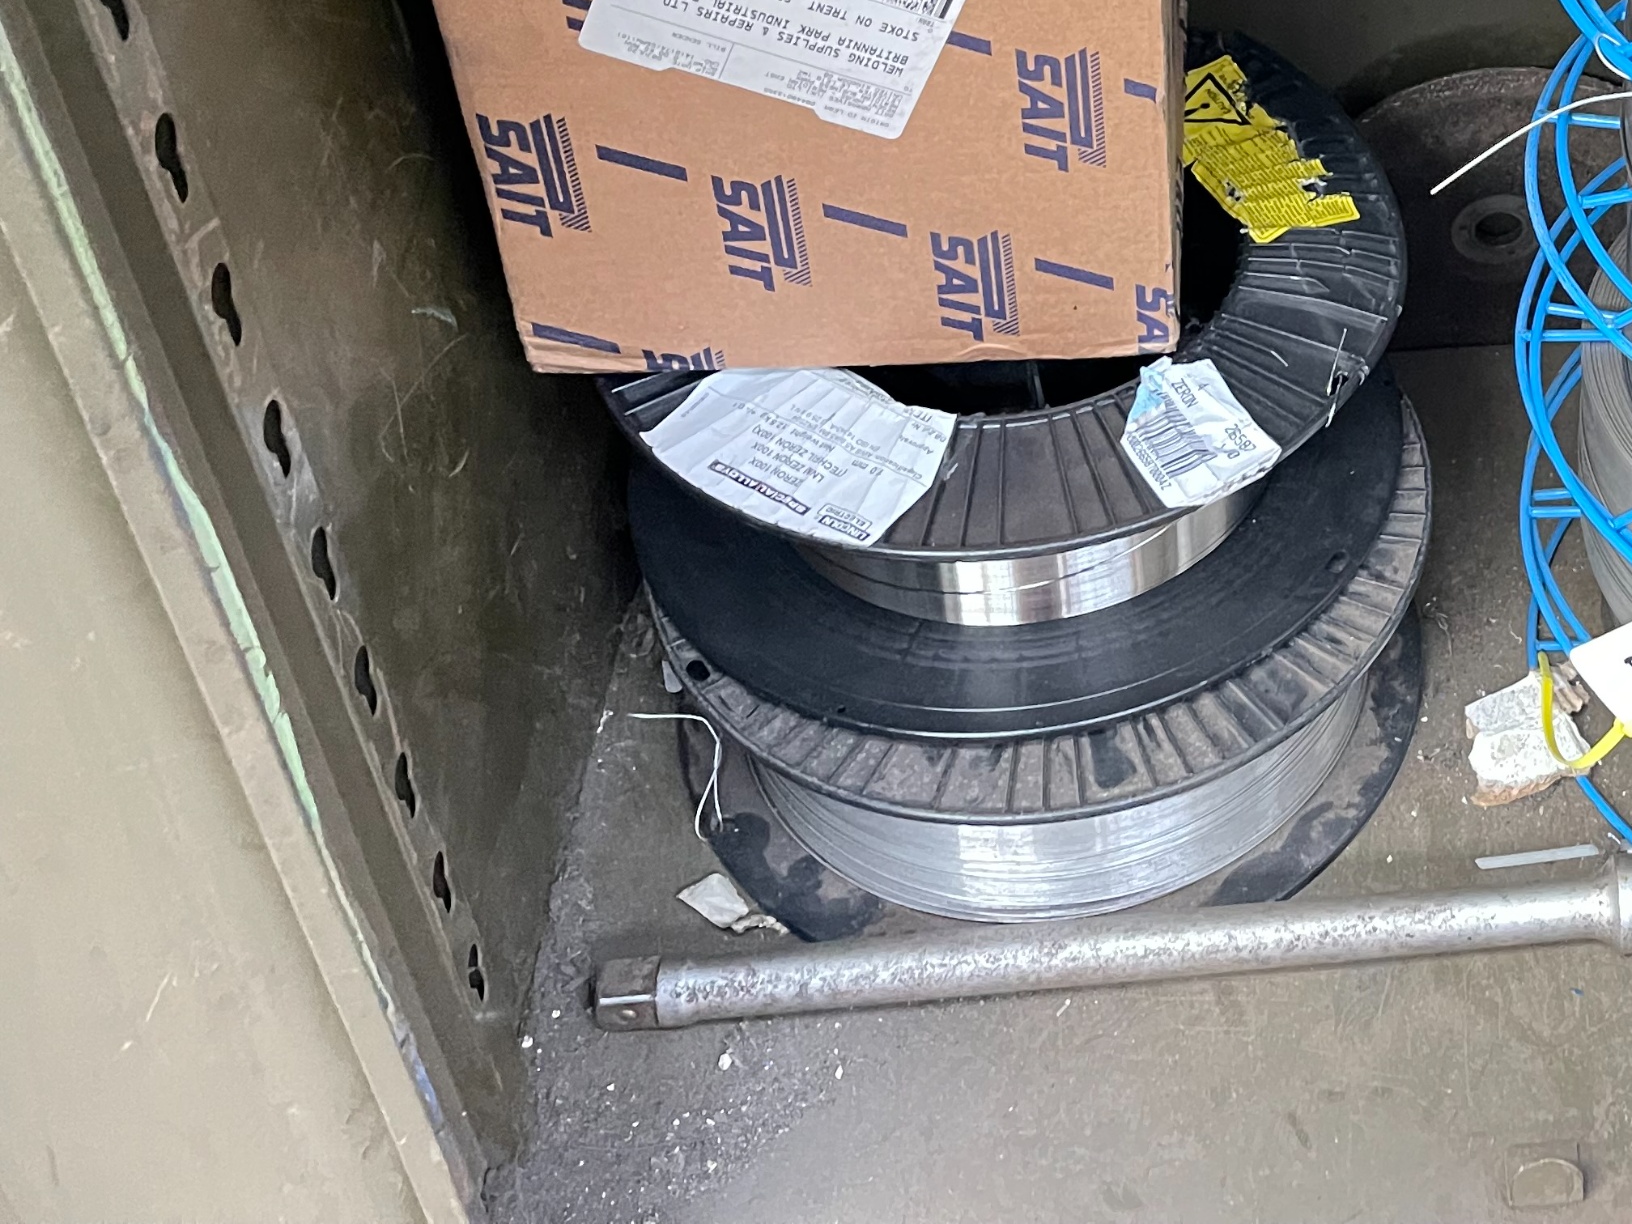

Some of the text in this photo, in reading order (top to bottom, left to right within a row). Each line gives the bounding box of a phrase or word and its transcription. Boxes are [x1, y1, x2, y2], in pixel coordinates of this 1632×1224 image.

[694, 5, 754, 32] REPAIRS
[854, 13, 873, 27] ON
[878, 21, 919, 42] STOKE
[776, 30, 841, 58] SUPPLIES
[796, 23, 831, 42] PARK
[836, 35, 908, 66] BRITANNIA
[846, 51, 903, 77] WELDING
[1014, 47, 1070, 173] SAIT
[475, 112, 554, 239] SAIT
[711, 174, 776, 293] SAIT
[929, 231, 985, 343] SAIT
[1171, 377, 1199, 409] ZERON
[750, 440, 773, 458] 100X
[775, 436, 808, 459] ZERON
[789, 427, 819, 447] weight
[747, 455, 804, 488] ZERON 100X
[770, 450, 805, 474] ZERON
[821, 515, 871, 542] LINCOLN
